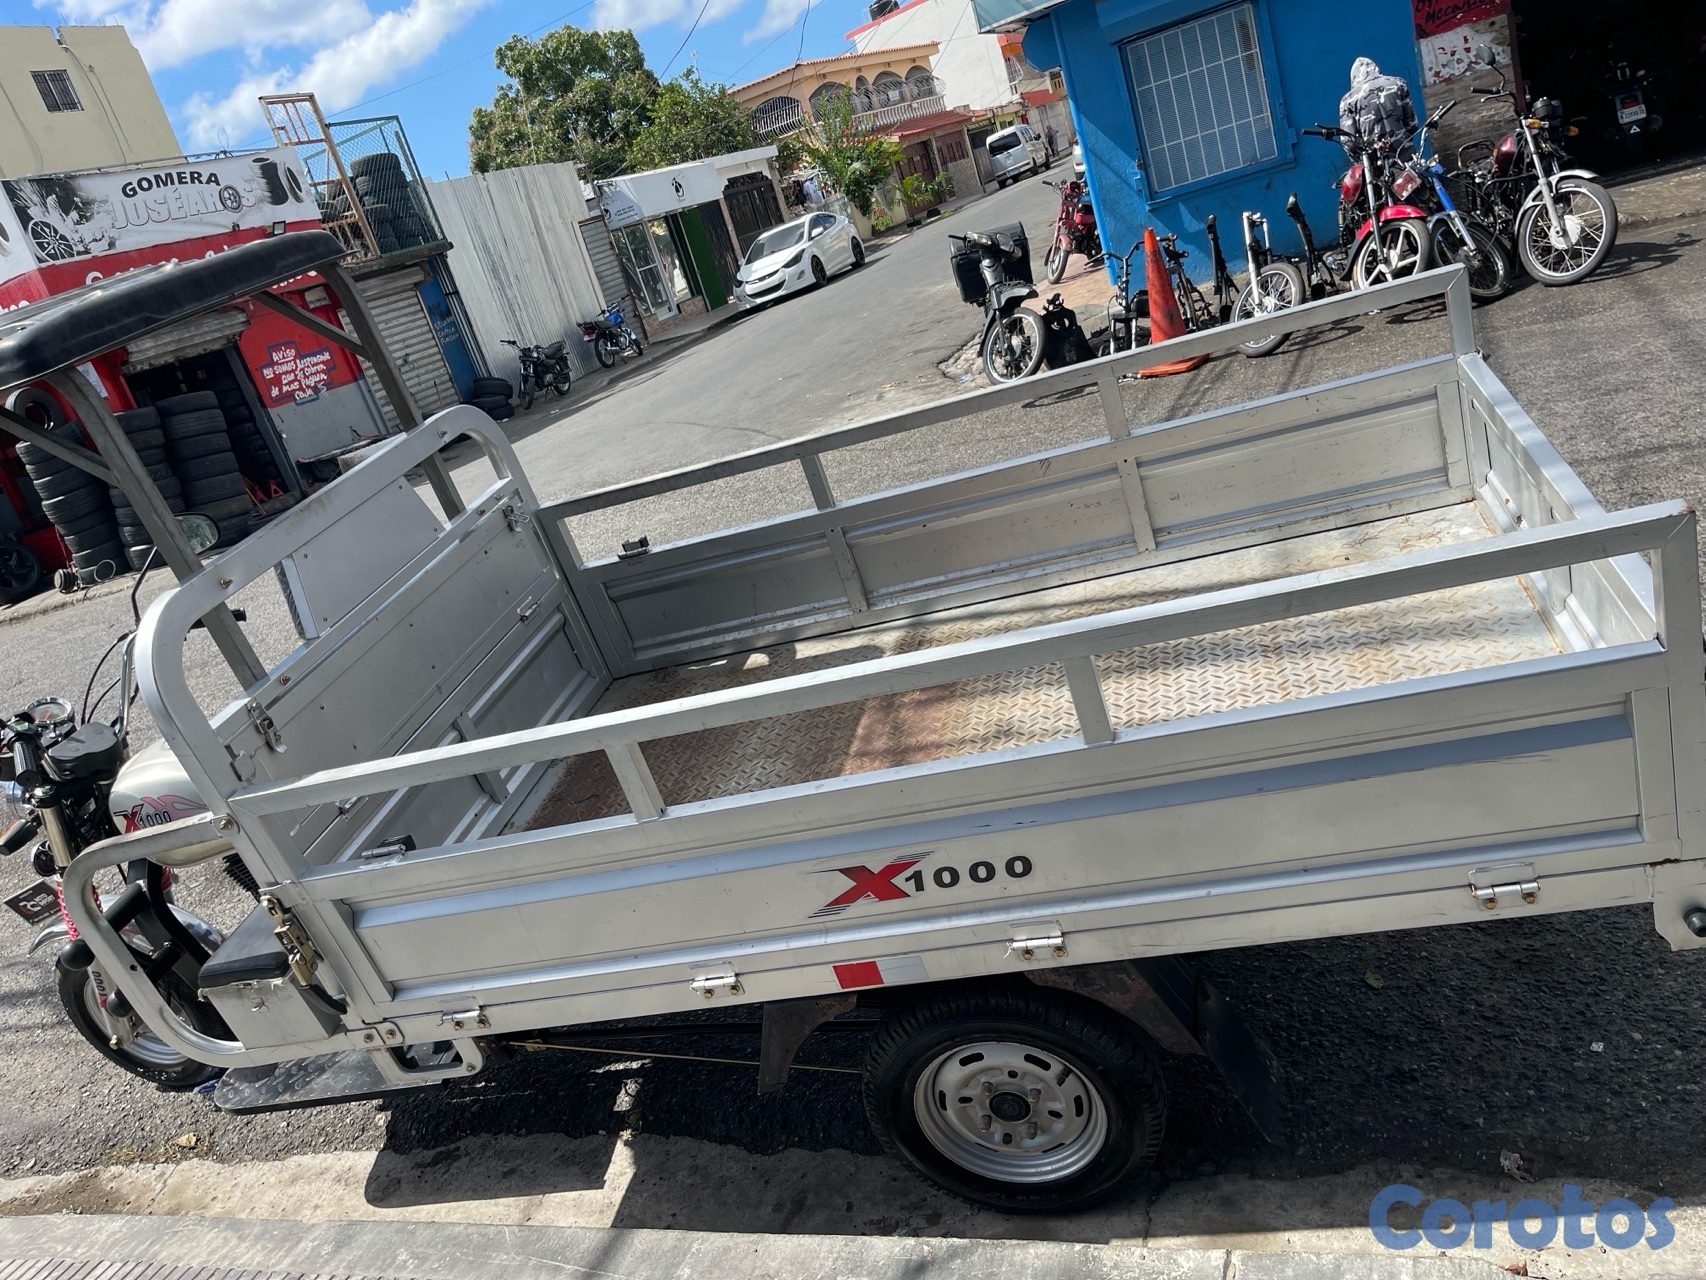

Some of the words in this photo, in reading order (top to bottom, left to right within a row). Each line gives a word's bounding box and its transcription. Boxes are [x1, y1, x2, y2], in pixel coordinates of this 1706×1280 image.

[121, 170, 221, 199] GOMERA
[113, 803, 172, 834] X1000
[816, 852, 1033, 912] X1000
